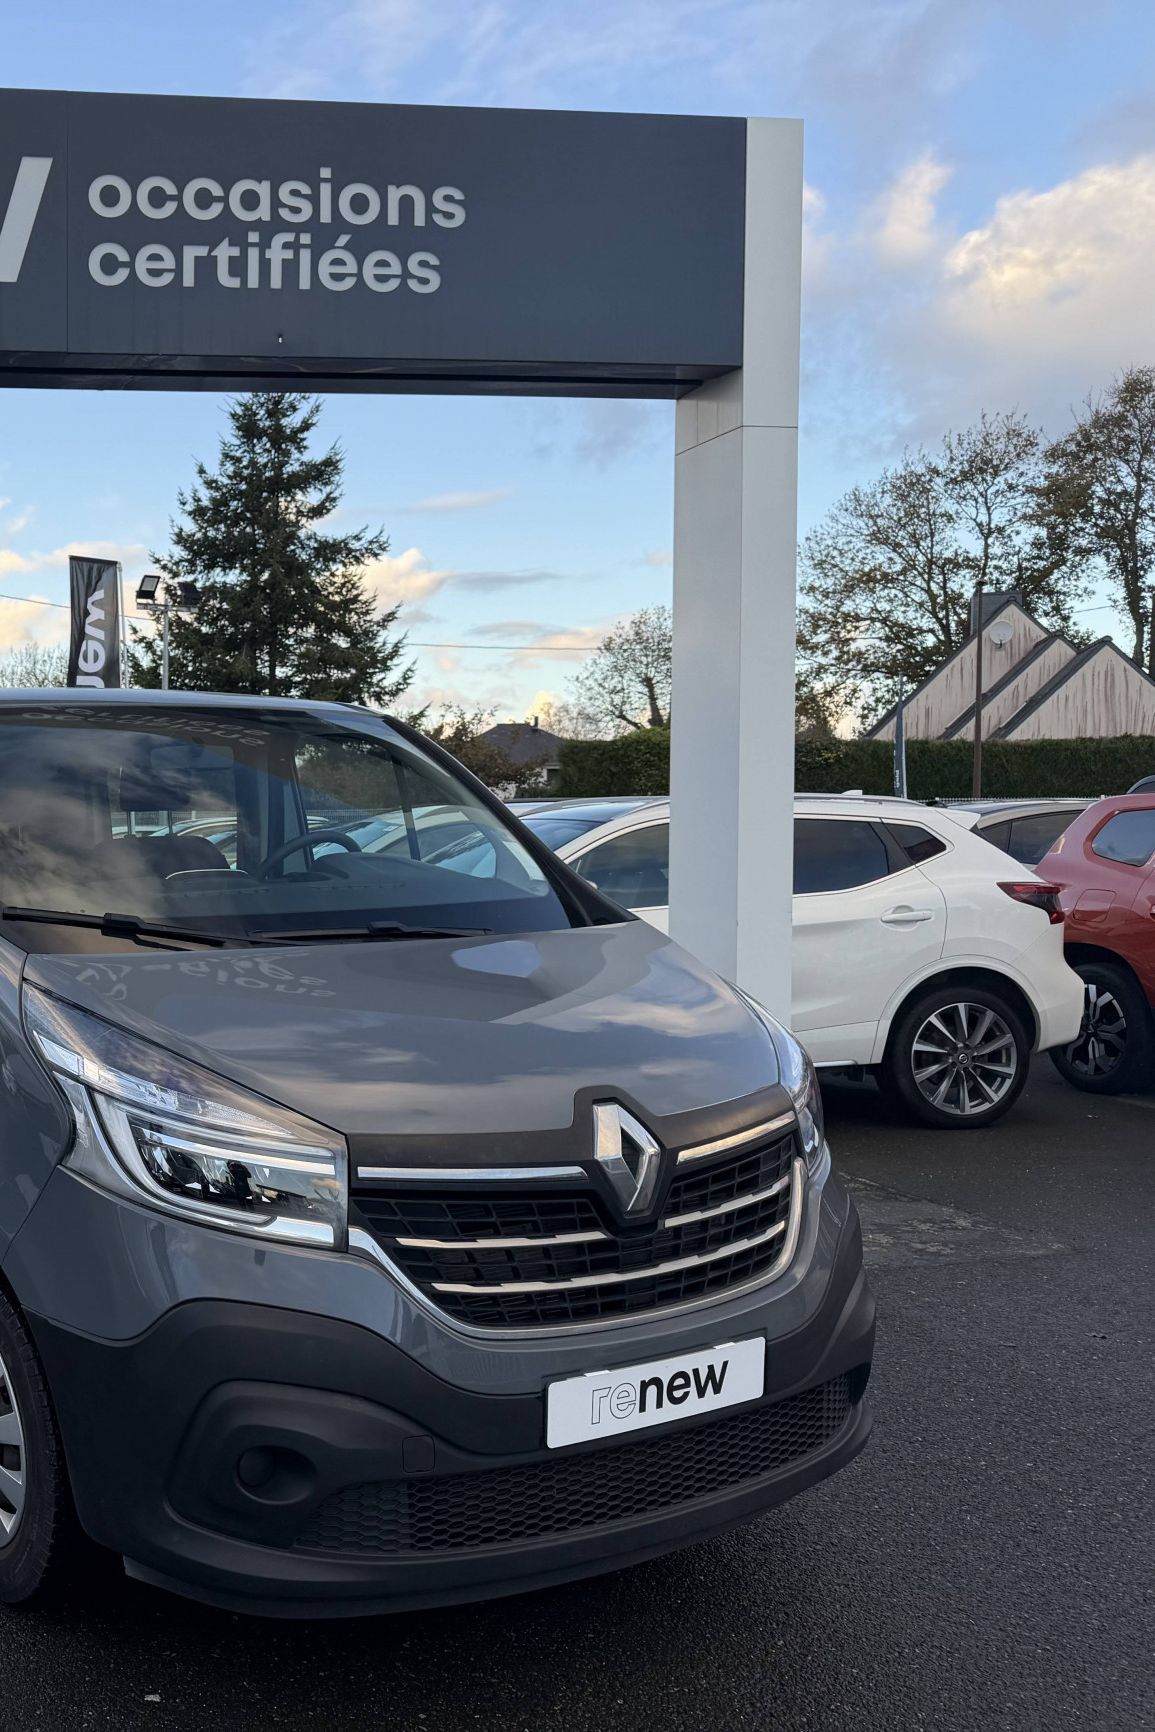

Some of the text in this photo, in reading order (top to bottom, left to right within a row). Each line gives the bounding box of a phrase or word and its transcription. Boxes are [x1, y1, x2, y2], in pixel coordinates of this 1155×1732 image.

[88, 167, 466, 228] occasions
[88, 231, 441, 293] certifiées
[591, 1360, 729, 1425] renew
